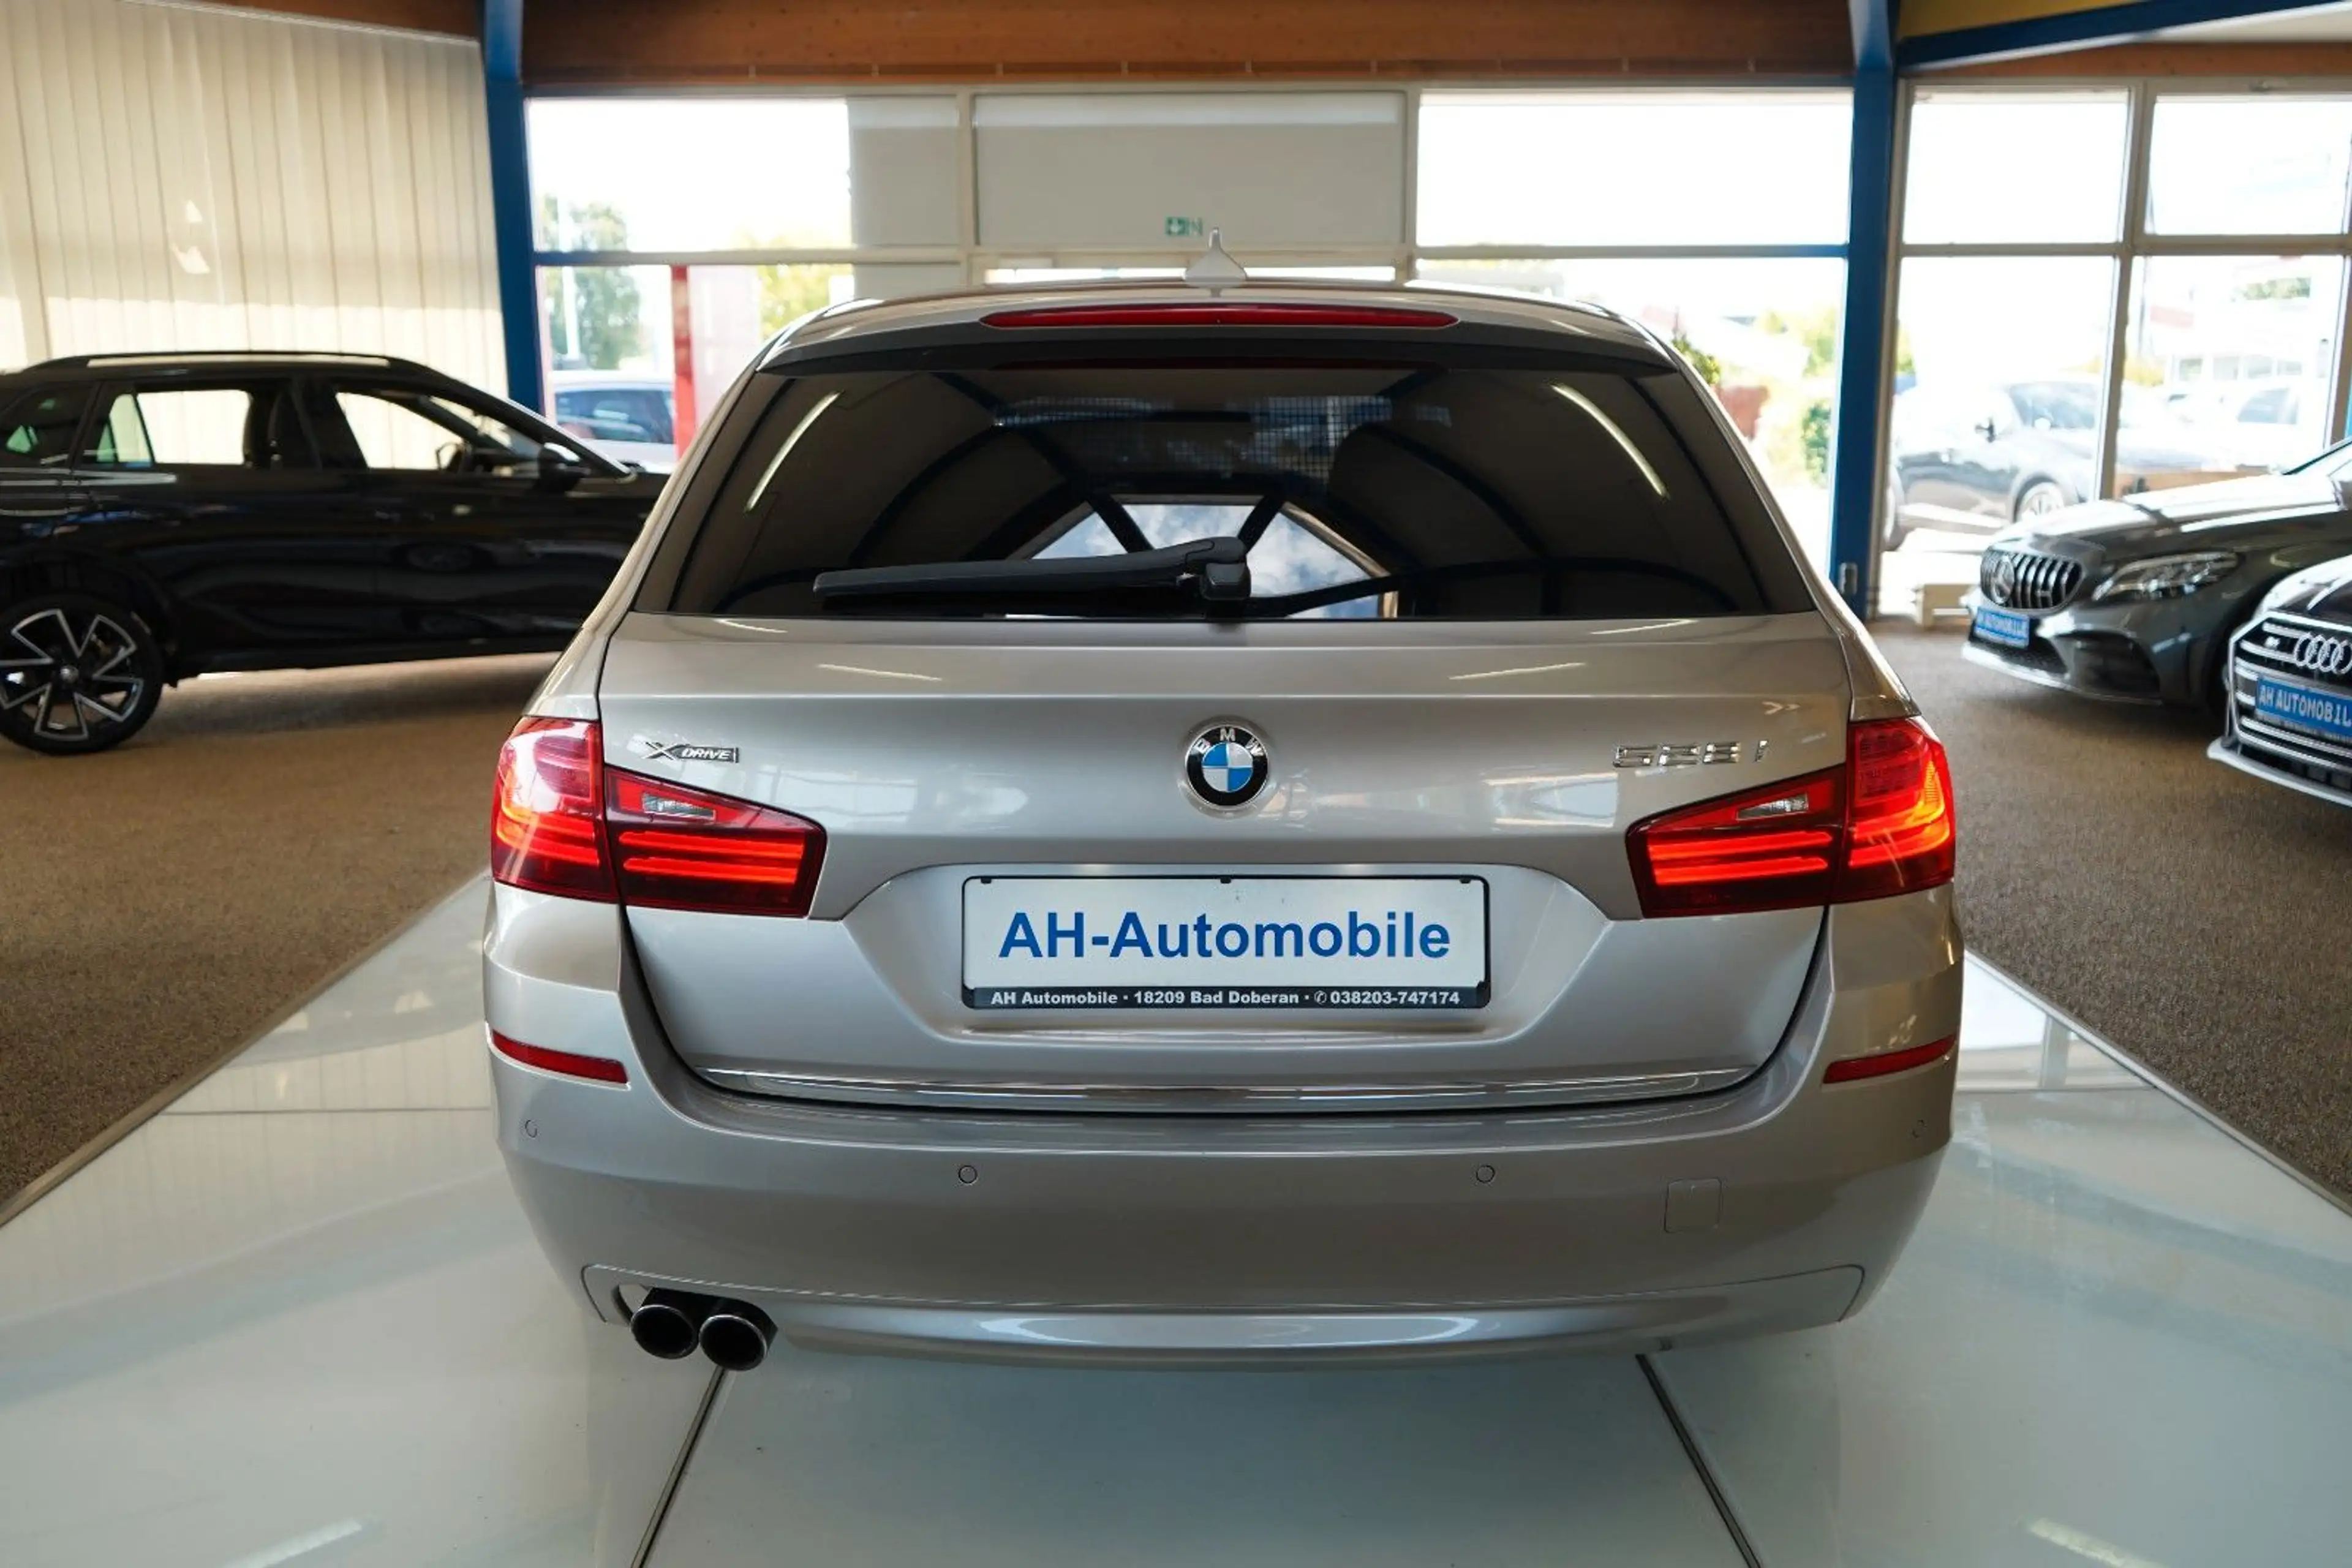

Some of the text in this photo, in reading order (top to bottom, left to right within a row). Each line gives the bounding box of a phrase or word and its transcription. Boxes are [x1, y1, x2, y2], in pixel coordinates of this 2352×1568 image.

[2259, 685, 2274, 707] AH
[1193, 728, 1264, 756] BMW
[998, 911, 1450, 958] AH-Automobile
[991, 990, 1460, 1005] AH Automobile 18209 Bad Doberan 038203-747174
